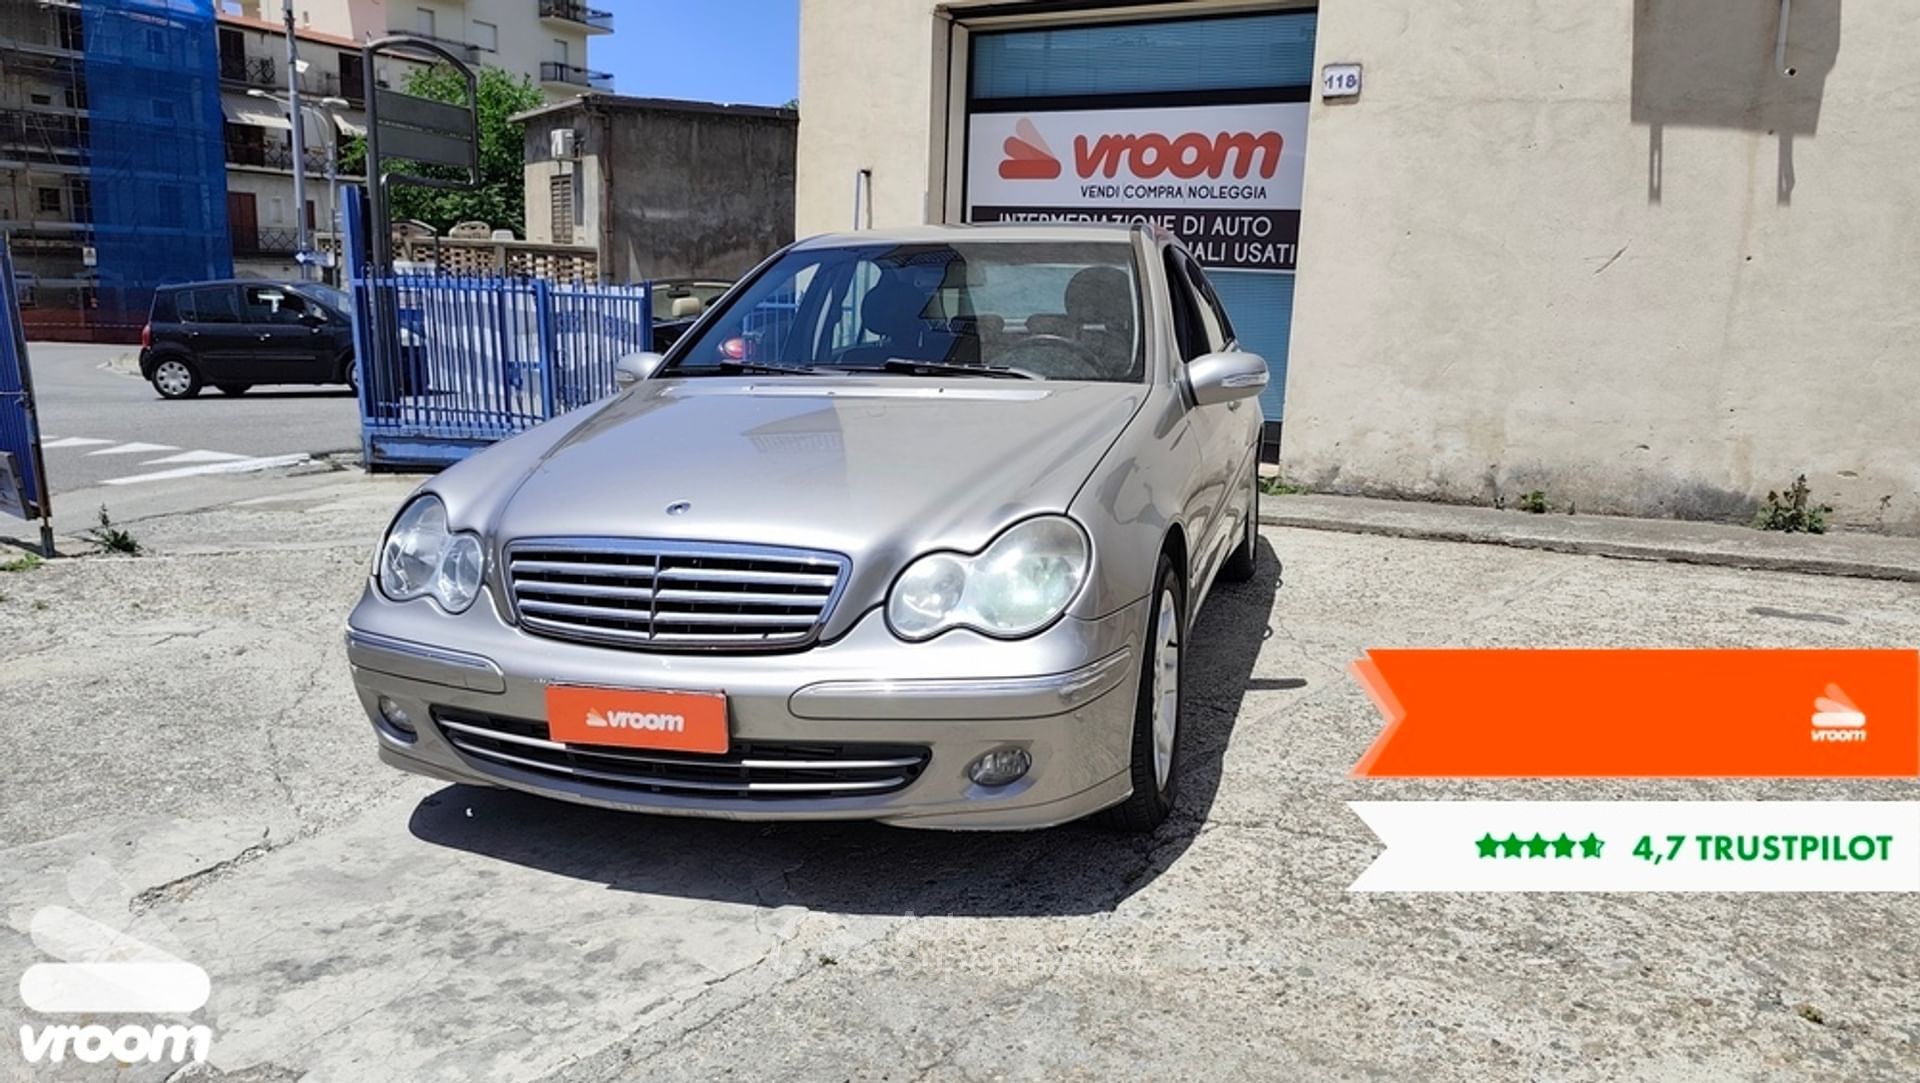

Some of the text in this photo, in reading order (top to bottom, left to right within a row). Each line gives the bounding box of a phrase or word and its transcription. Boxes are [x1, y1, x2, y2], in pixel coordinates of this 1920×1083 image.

[1327, 74, 1357, 89] 118
[1073, 131, 1284, 179] vroom
[1080, 185, 1267, 200] VENDI COMPRA NOLEGGIA
[1182, 215, 1205, 236] DI
[1211, 216, 1272, 237] AUTO
[1234, 242, 1296, 264] USATI
[607, 710, 685, 732] vroom
